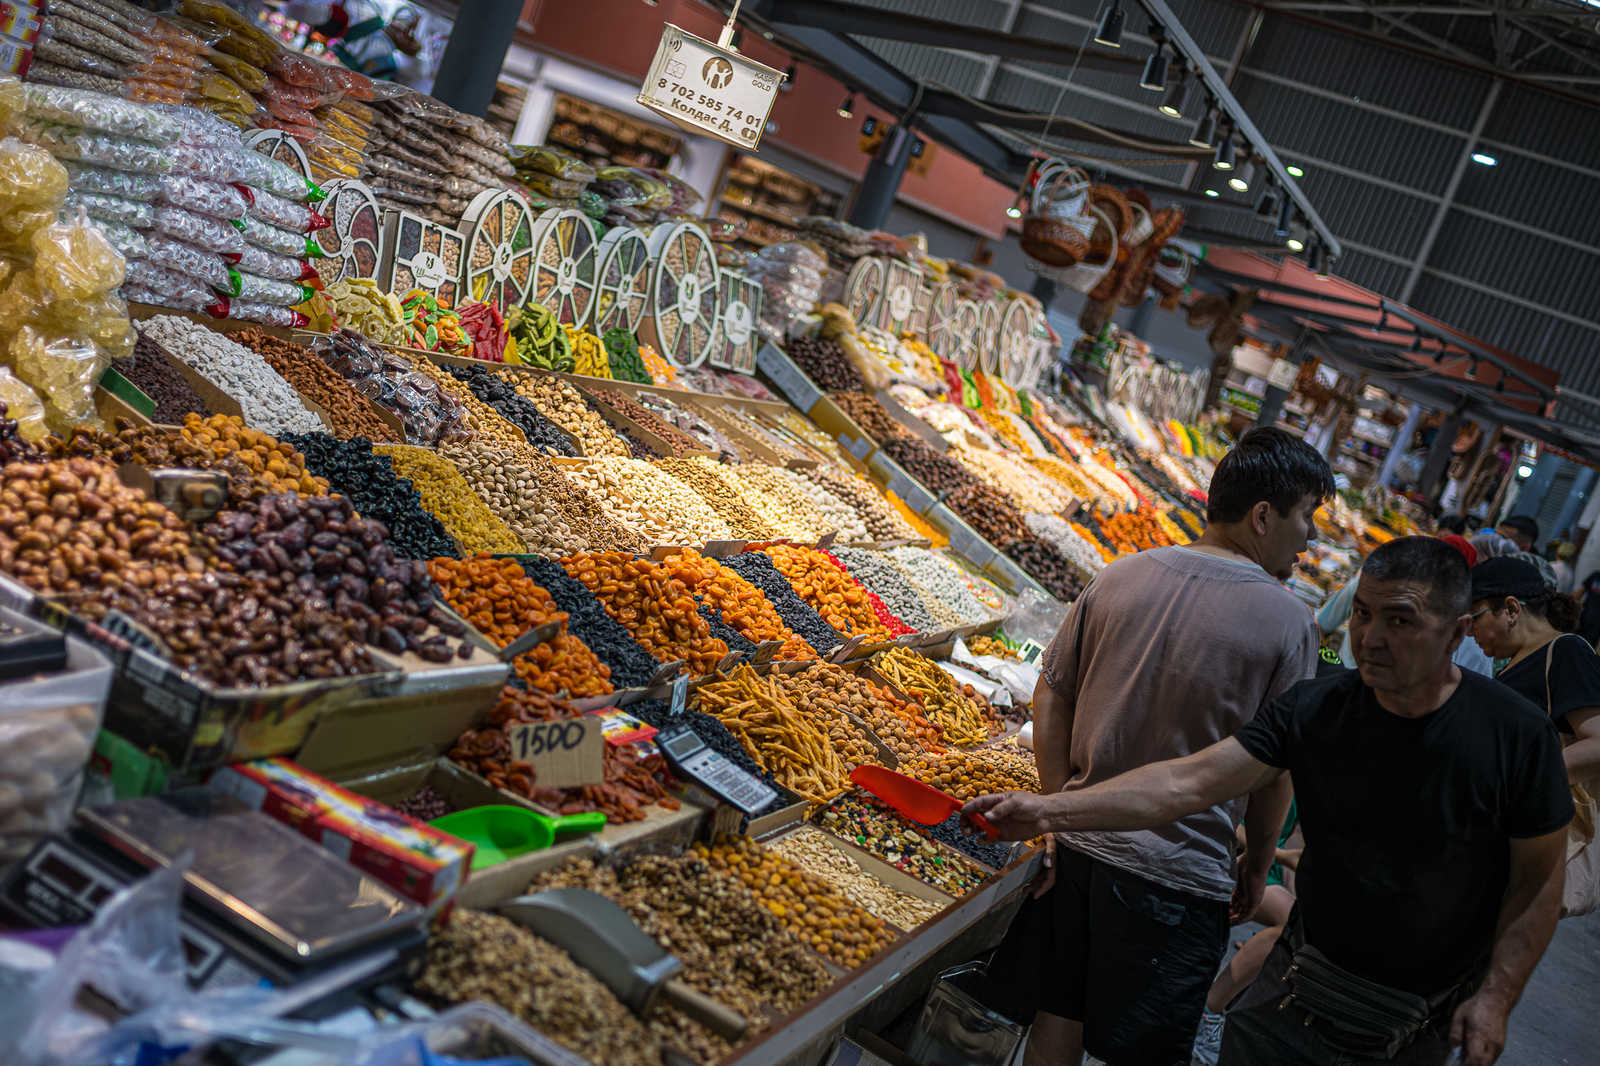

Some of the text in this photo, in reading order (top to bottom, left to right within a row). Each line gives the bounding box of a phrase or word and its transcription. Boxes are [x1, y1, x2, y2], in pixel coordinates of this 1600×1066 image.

[658, 78, 667, 89] 8
[671, 83, 694, 101] 702
[697, 95, 723, 111] 585
[726, 106, 743, 120] 74
[746, 115, 761, 128] 01
[751, 79, 771, 92] GOLD
[671, 98, 717, 125] Колдас
[718, 120, 733, 133] Д.
[516, 721, 586, 759] 1500
